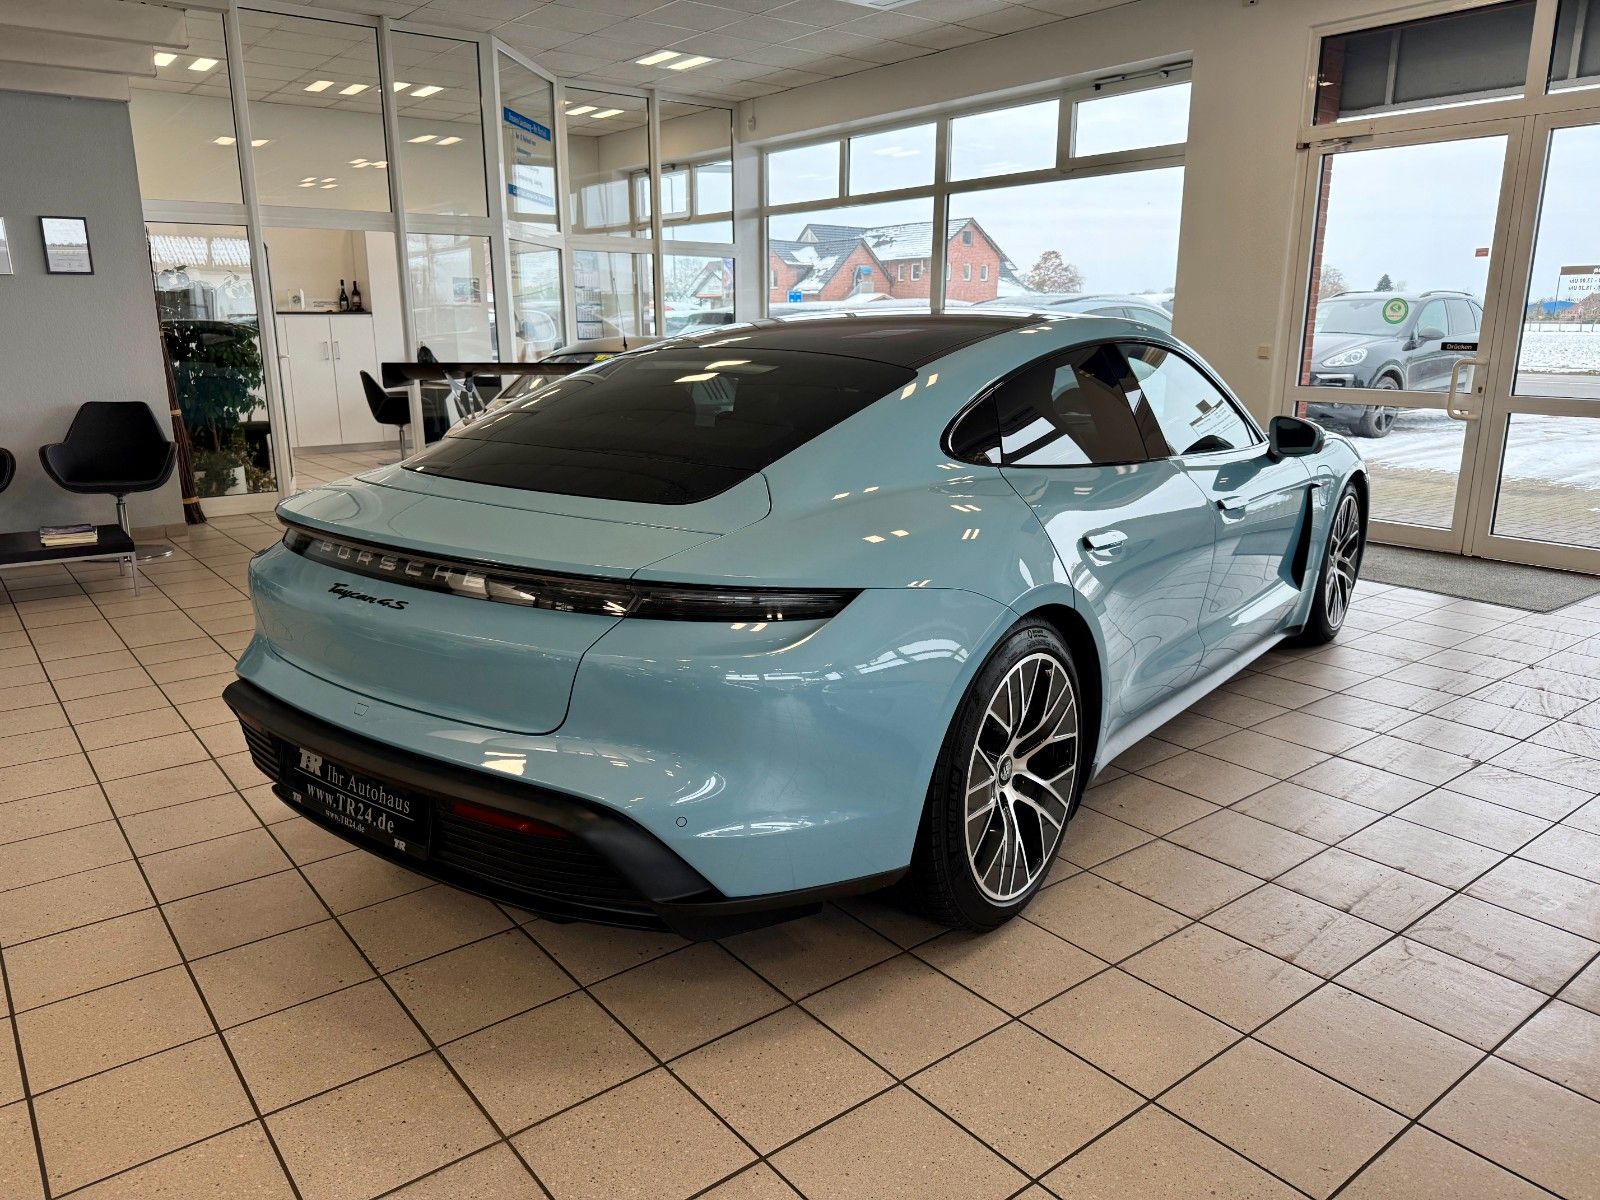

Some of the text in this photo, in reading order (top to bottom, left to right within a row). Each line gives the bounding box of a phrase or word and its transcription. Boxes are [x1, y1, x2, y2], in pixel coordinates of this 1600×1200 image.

[320, 541, 487, 588] PORSCHE
[307, 783, 395, 834] www.TR24.de
[327, 764, 345, 787] Ihr
[347, 775, 411, 814] Autohaus
